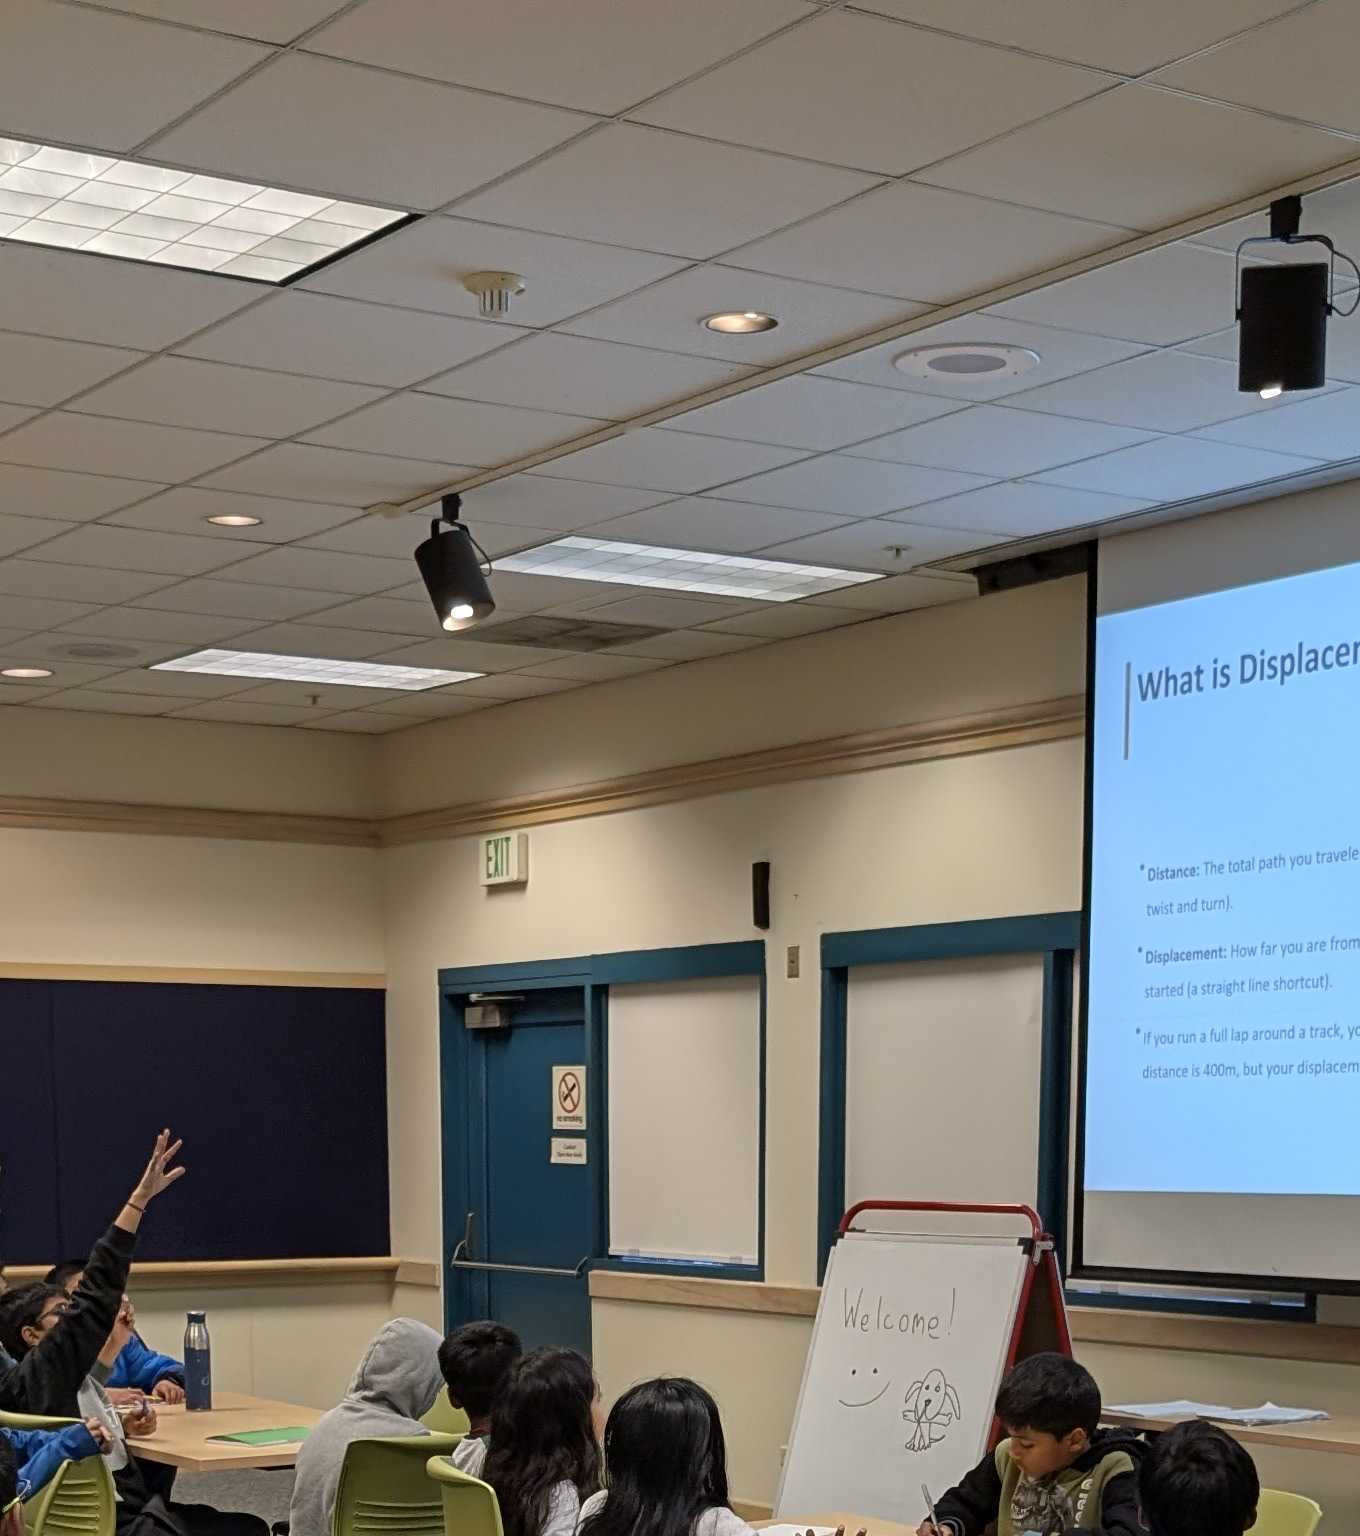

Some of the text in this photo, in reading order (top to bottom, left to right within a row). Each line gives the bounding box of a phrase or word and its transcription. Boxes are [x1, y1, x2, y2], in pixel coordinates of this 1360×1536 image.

[1139, 664, 1204, 701] What
[1212, 658, 1230, 689] is
[486, 837, 511, 879] EXIT
[1147, 865, 1200, 881] Distance:
[1204, 861, 1224, 876] The
[1228, 859, 1255, 874] total
[1258, 856, 1286, 873] path
[1289, 854, 1311, 870] you
[1147, 895, 1233, 916] twist and turn).
[1145, 948, 1227, 966] Displacement:
[1231, 944, 1257, 958] How
[1260, 941, 1277, 956] far
[1280, 943, 1303, 958] you
[1306, 940, 1326, 953] are
[1330, 935, 1360, 951] from
[1144, 973, 1332, 998] started (a straight line shortcut).
[1143, 1031, 1152, 1045] If
[1154, 1033, 1174, 1048] you
[1177, 1033, 1196, 1044] run
[1199, 1032, 1206, 1042] a
[1210, 1027, 1227, 1043] full
[1231, 1027, 1248, 1044] lap
[1252, 1026, 1295, 1041] around
[1298, 1029, 1305, 1039] a
[1309, 1023, 1343, 1040] track,
[1142, 1065, 1188, 1079] distance
[1192, 1064, 1200, 1077] is
[1203, 1063, 1239, 1078] 400m,
[1243, 1062, 1262, 1075] but
[1266, 1063, 1293, 1077] your
[844, 1288, 956, 1339] Welcome!
